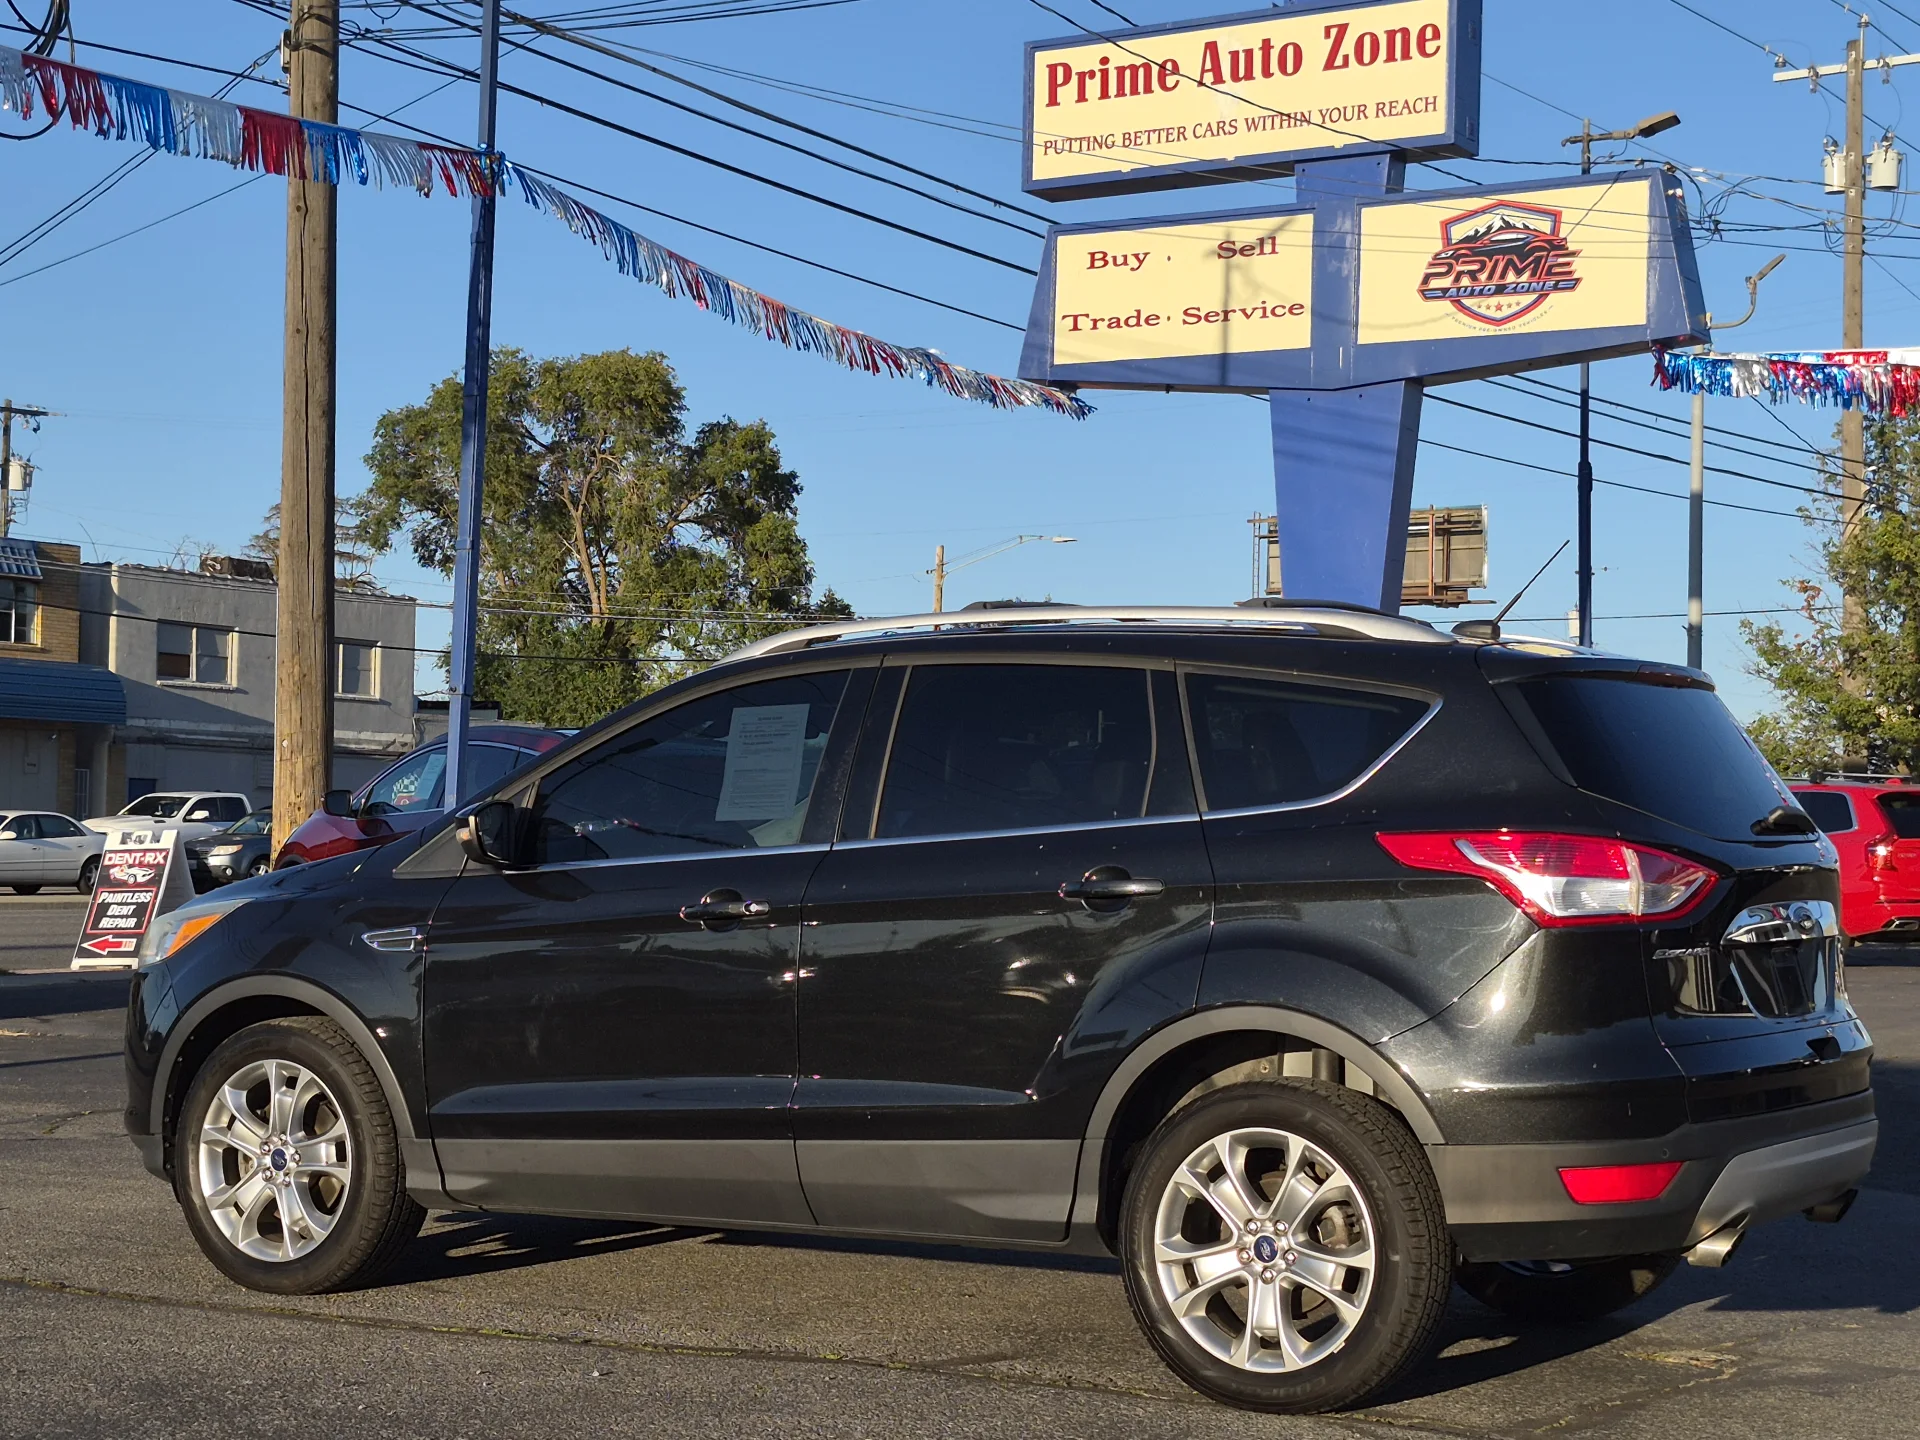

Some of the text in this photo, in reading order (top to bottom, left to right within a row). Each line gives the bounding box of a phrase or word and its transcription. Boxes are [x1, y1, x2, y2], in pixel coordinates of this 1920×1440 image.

[1045, 22, 1441, 108] Prime Auto Zone
[1043, 95, 1438, 156] PUTTING BETTER CARS WITHIN YOUR REACH
[1086, 236, 1279, 272] Buy Sell
[1418, 249, 1583, 287] PRIME
[1444, 280, 1556, 298] AUTO ZONE
[1061, 300, 1305, 332] Trade Service
[103, 851, 168, 866] DENT-RX
[98, 892, 153, 903] PAINTLESS
[106, 904, 137, 915] DENT
[98, 917, 137, 929] REPAIR
